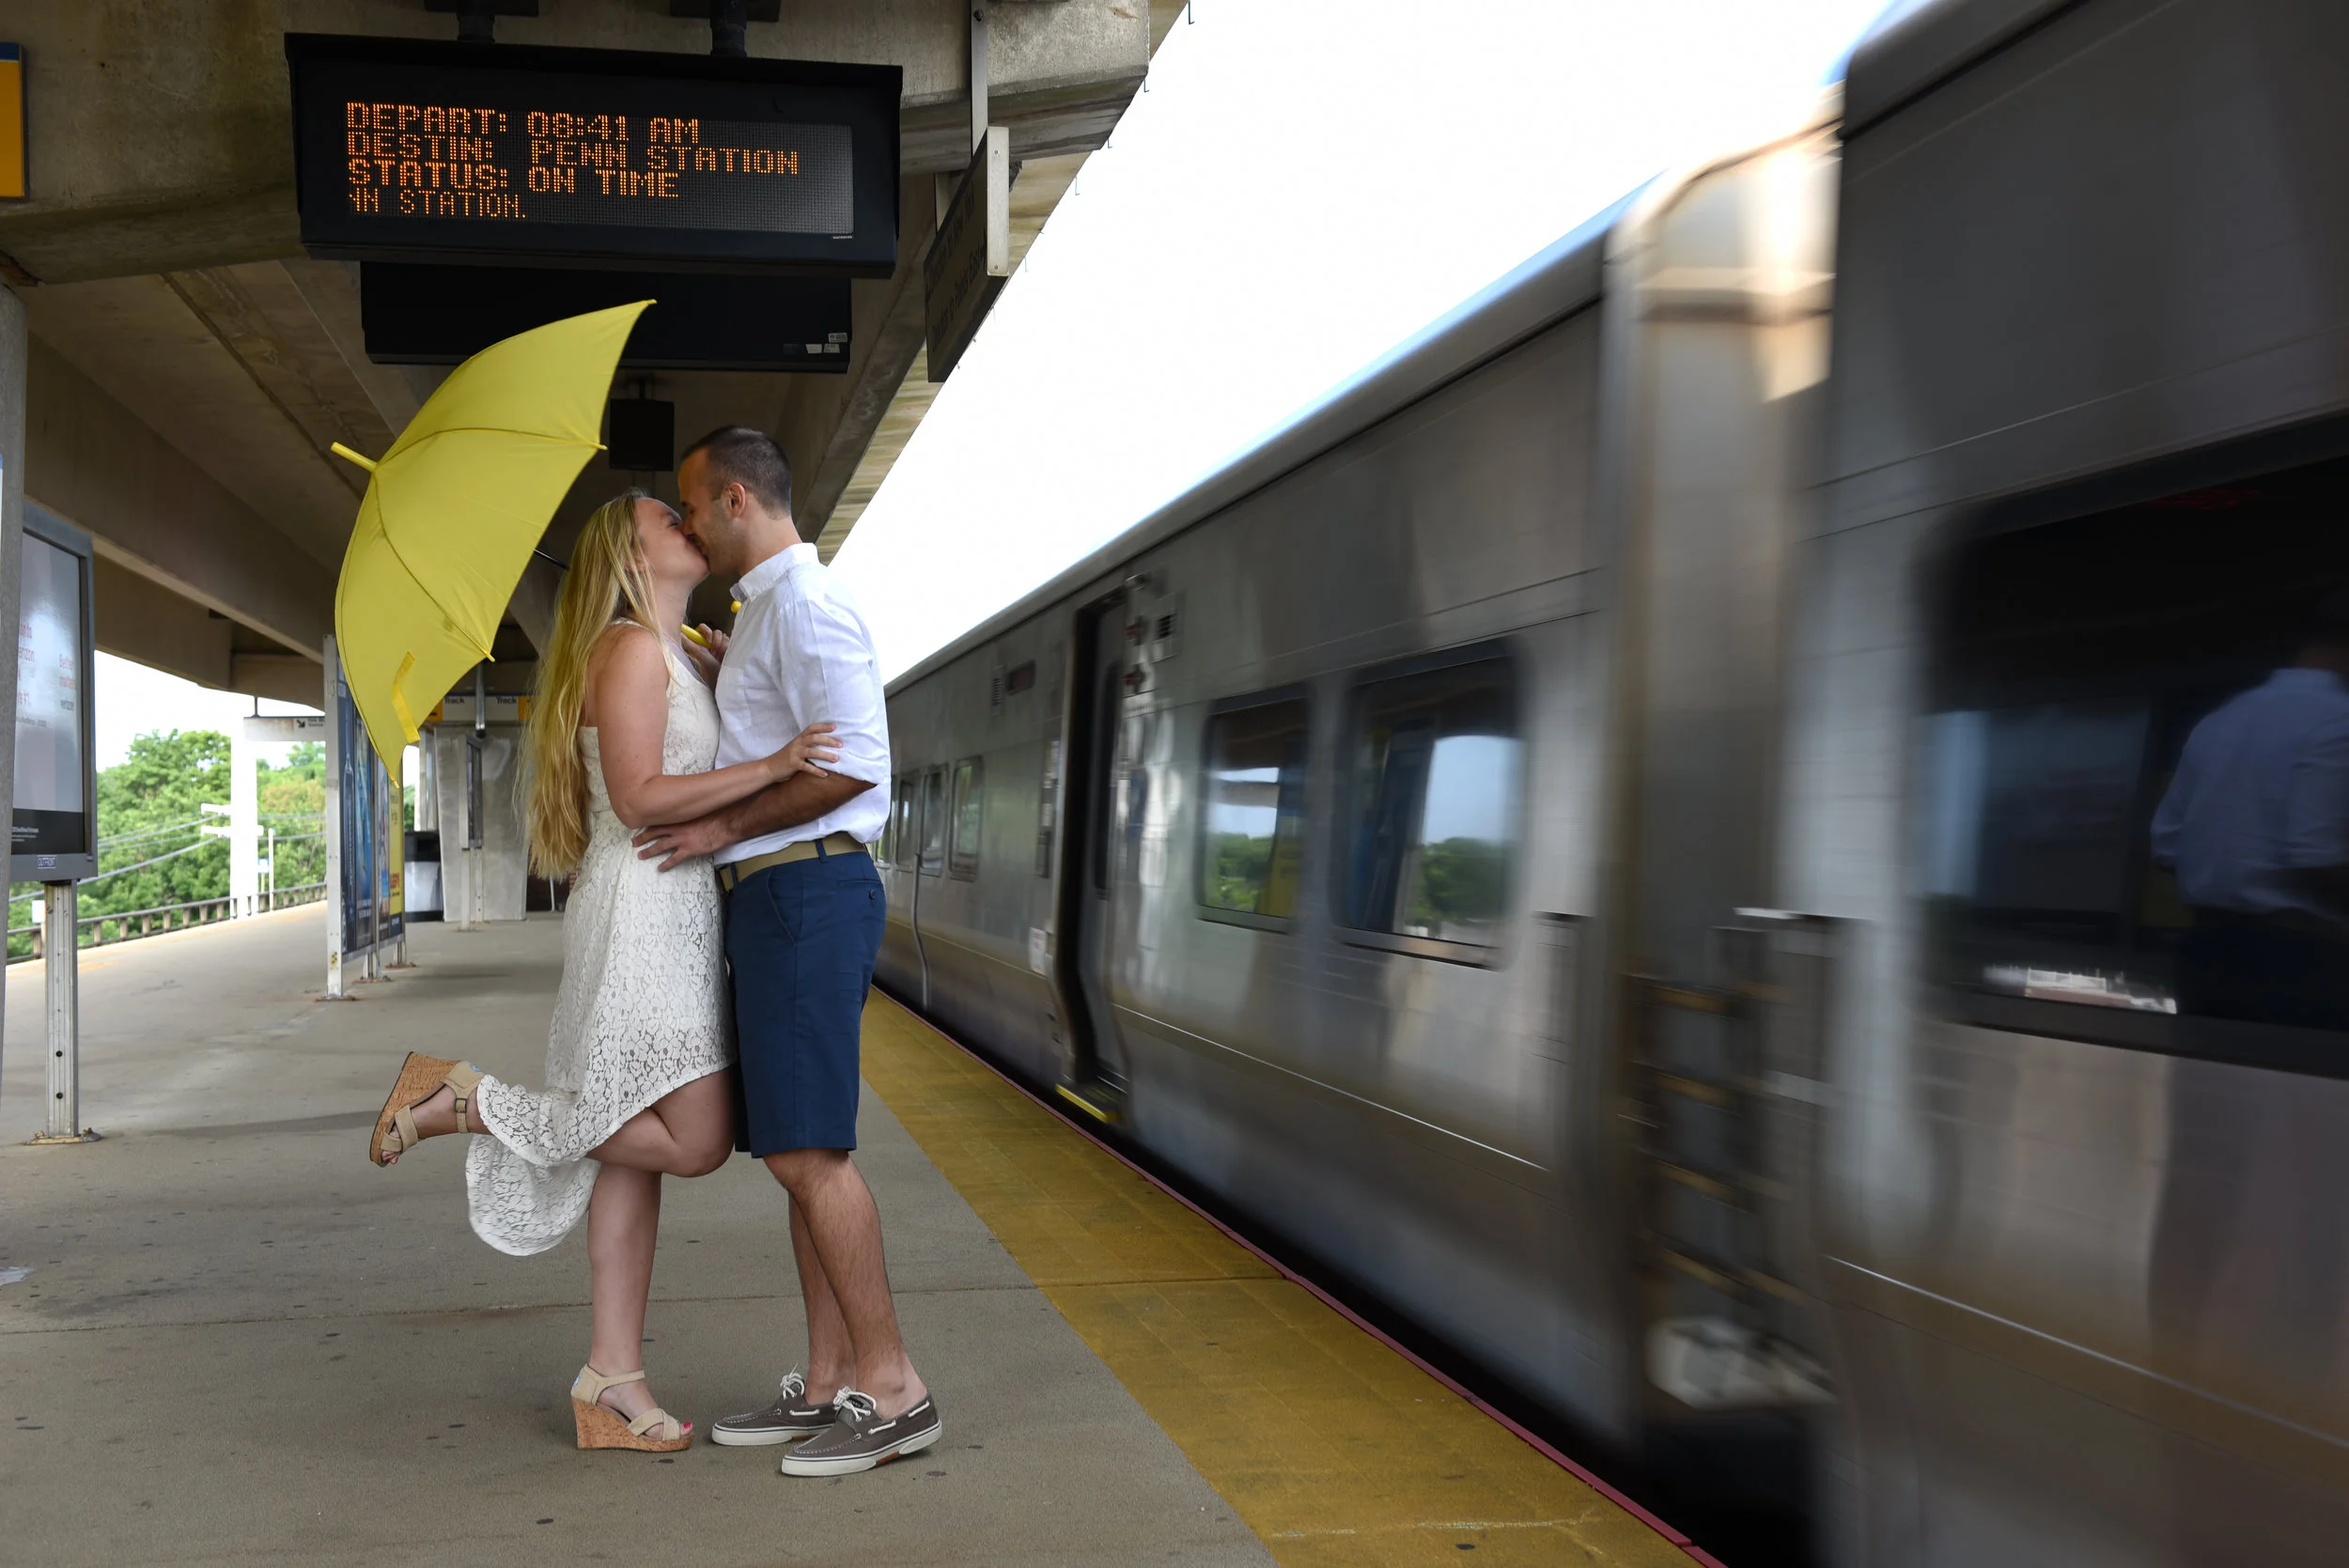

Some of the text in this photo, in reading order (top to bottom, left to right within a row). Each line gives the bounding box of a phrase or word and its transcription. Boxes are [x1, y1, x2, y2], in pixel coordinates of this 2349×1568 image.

[348, 102, 698, 144] DEPART: 08:41 AM
[348, 132, 798, 175] DESTIN: PENN STATION
[349, 159, 679, 197] STATUS: ON TIME
[399, 190, 526, 219] STATION.
